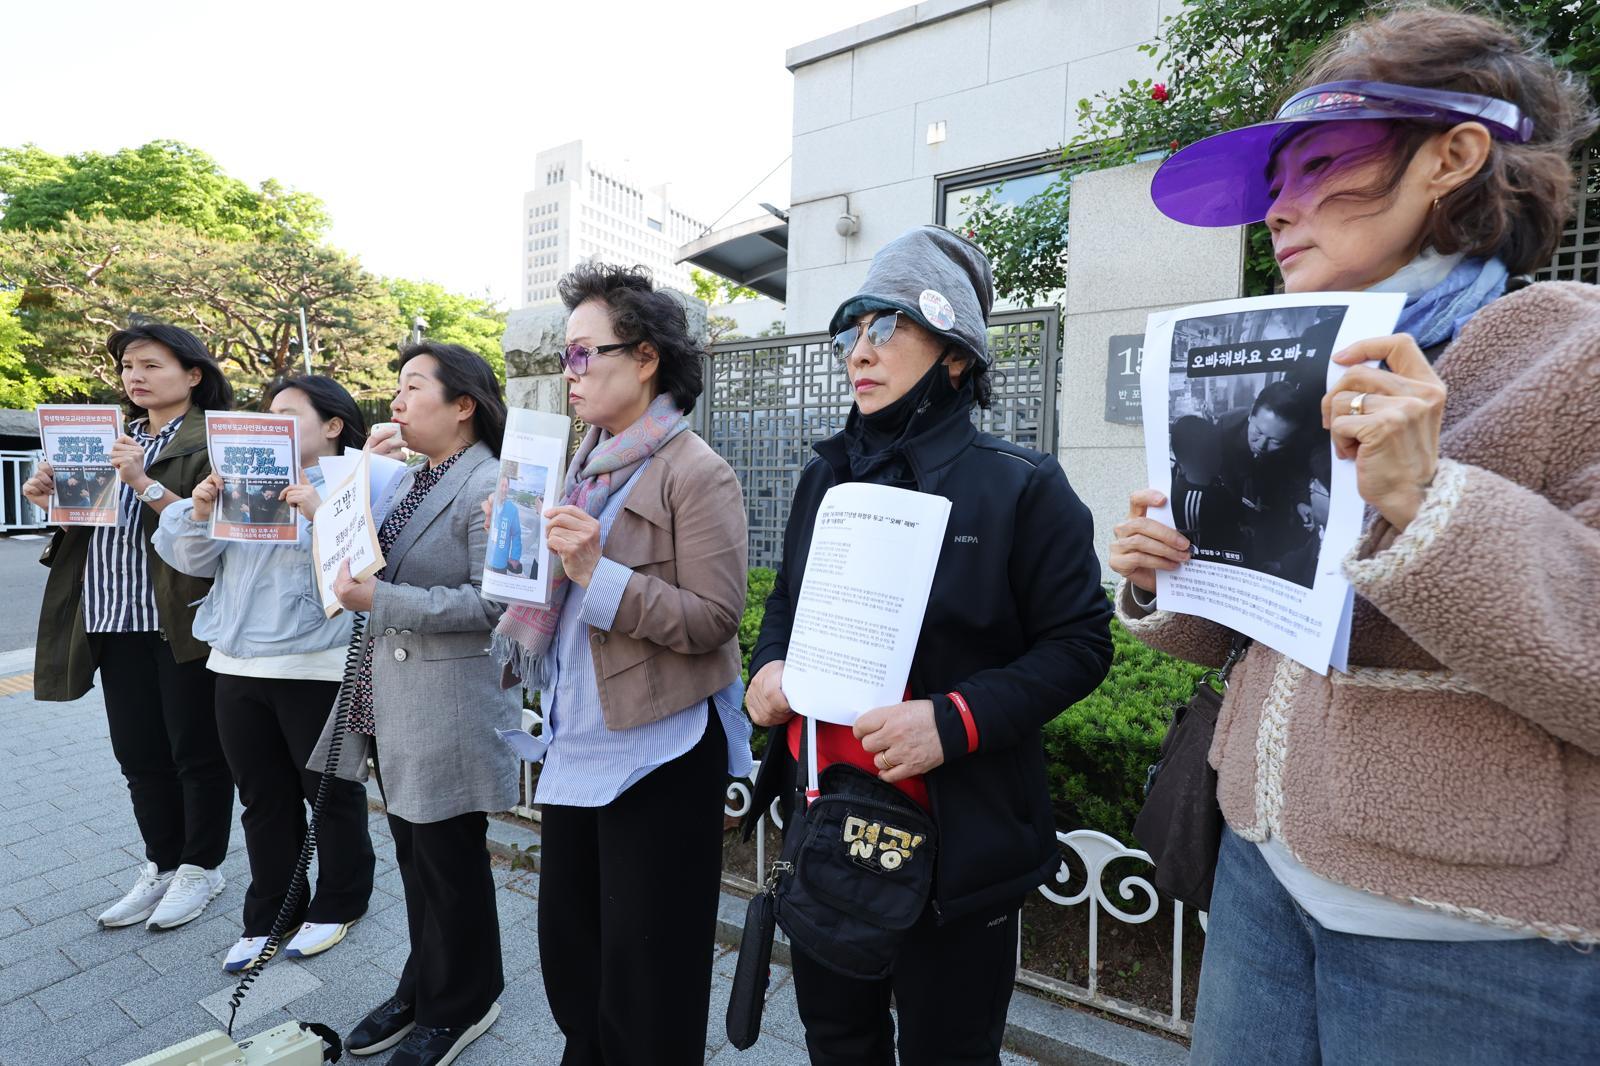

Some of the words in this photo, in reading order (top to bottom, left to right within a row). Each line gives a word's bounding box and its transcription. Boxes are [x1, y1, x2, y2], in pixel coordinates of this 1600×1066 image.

[1191, 348, 1263, 368] 오빠해봐요
[1267, 343, 1302, 362] 오빠
[954, 535, 979, 544] NEPA
